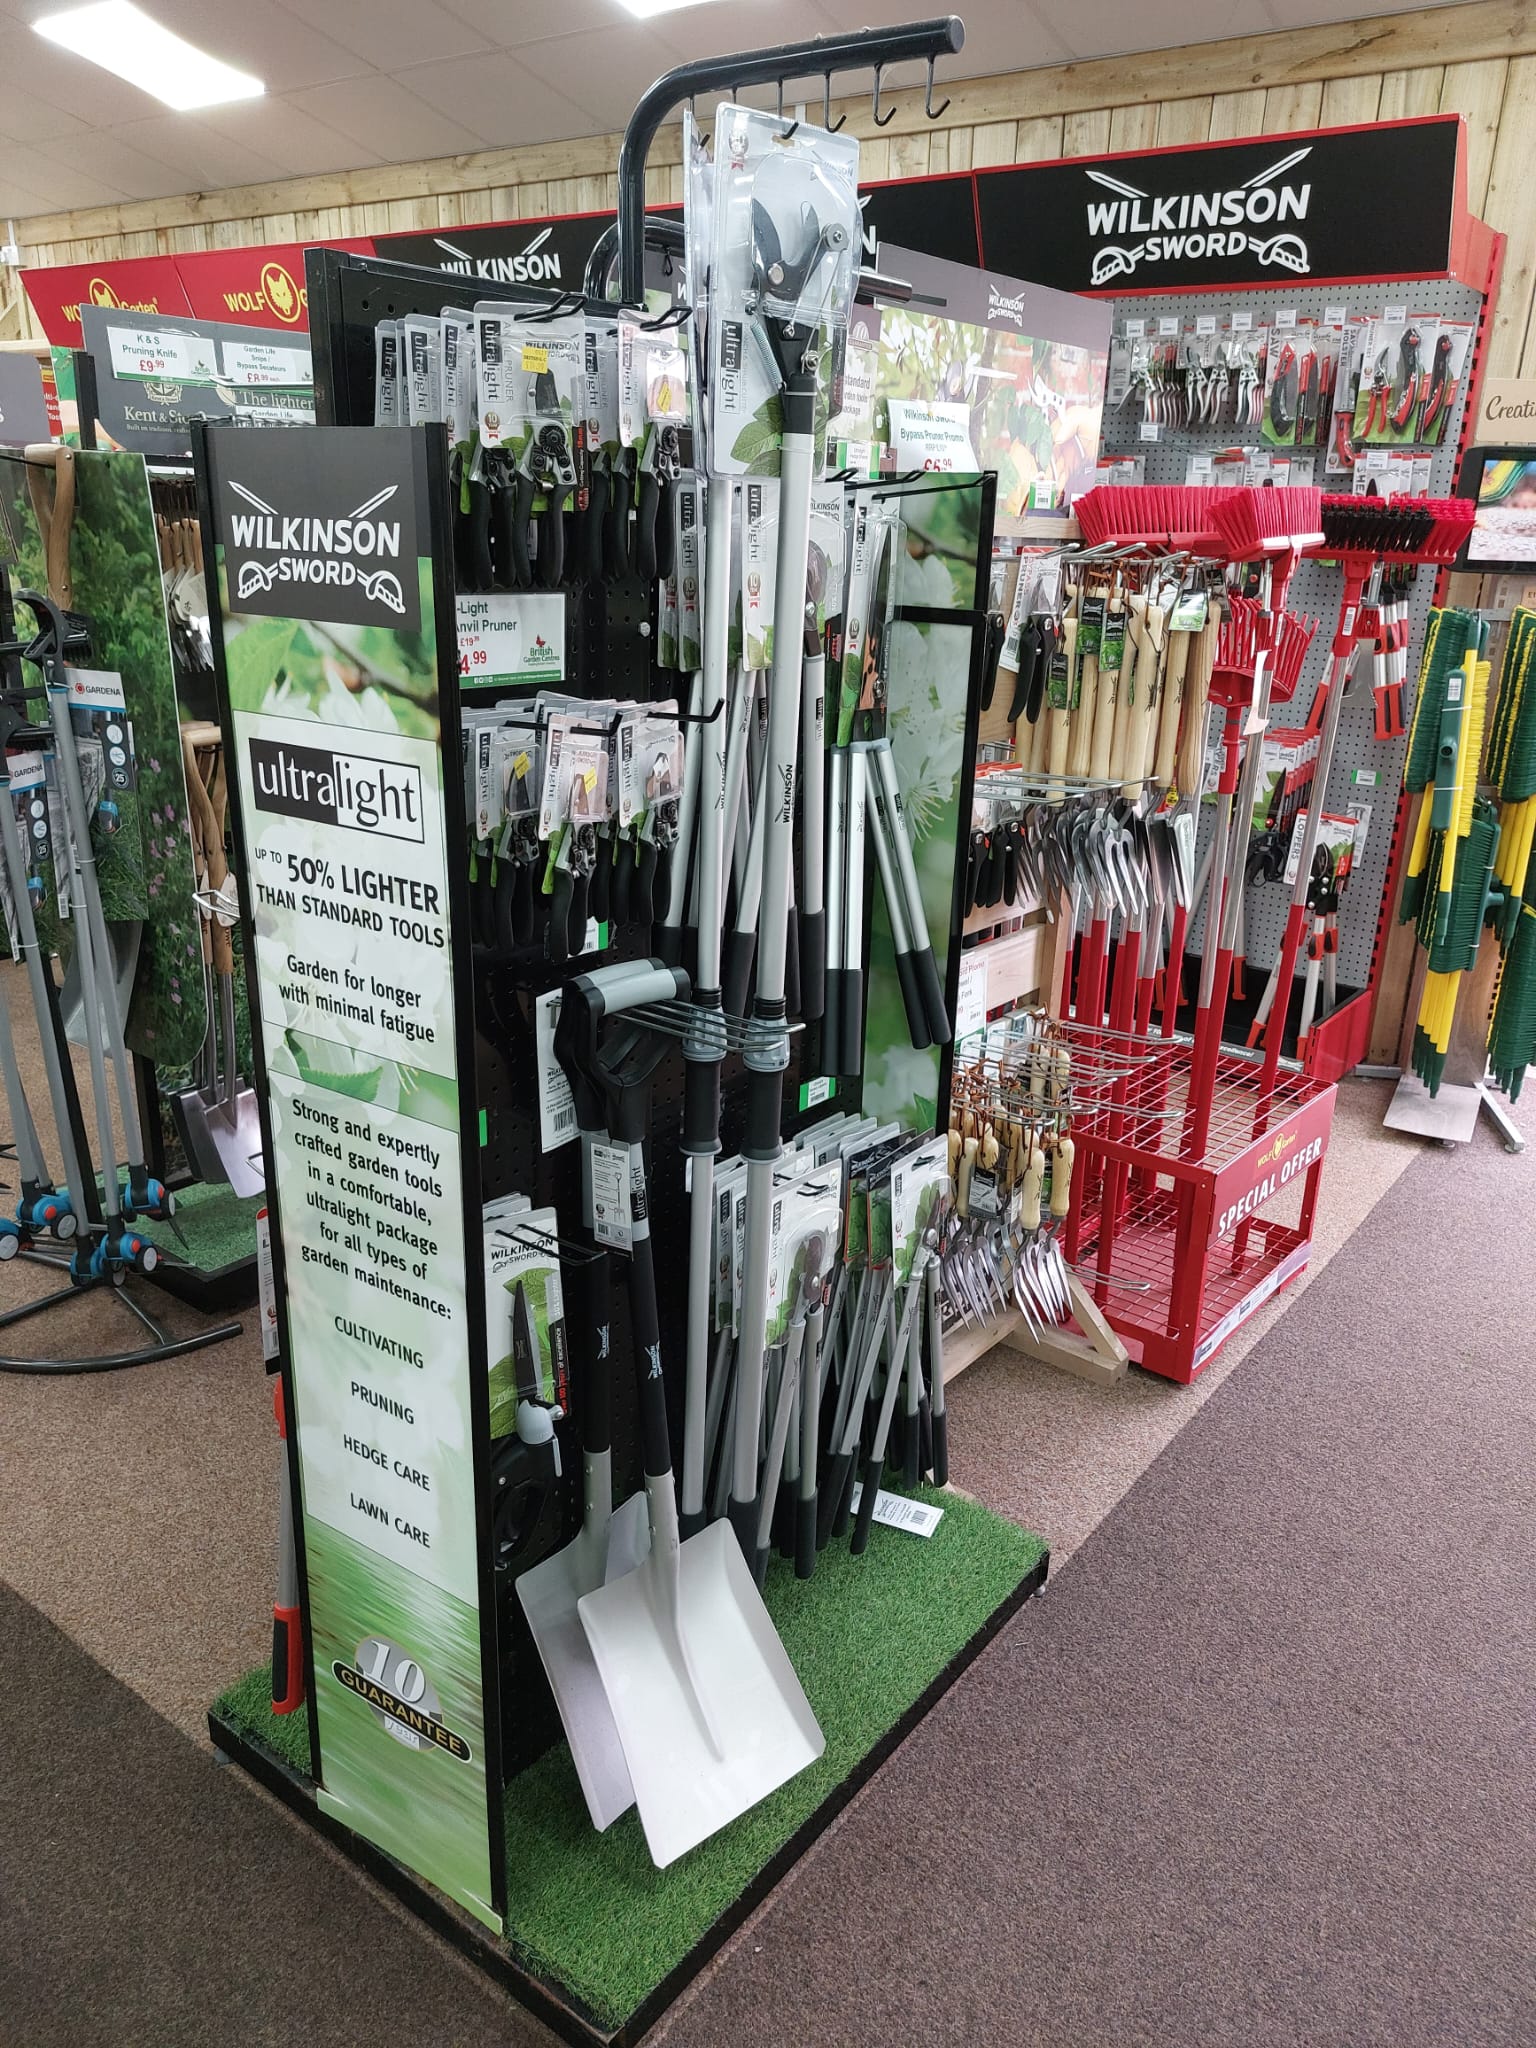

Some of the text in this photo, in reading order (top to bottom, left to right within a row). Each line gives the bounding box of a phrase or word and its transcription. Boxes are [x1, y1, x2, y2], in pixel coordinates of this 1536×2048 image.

[1087, 184, 1311, 235] WILKINSON
[1145, 232, 1247, 261] SWORD
[223, 293, 265, 313] WOLF
[988, 294, 1024, 312] WILKINSON
[122, 345, 178, 359] Pruning Knife
[136, 334, 161, 345] K & S
[446, 328, 458, 403] ultralight
[483, 322, 501, 401] ultralight
[1269, 327, 1281, 358] SAW
[139, 359, 165, 373] £9.99
[382, 340, 395, 412] ultralight
[413, 334, 428, 409] ultralight
[723, 322, 739, 410] ultralight
[124, 405, 190, 425] Kent & Sto
[239, 390, 313, 410] The lighter
[900, 428, 965, 442] Bypass Pruner Promo
[810, 502, 840, 512] ILKINSON
[1355, 466, 1366, 496] SHE
[231, 514, 400, 557] WILKINSON
[682, 494, 695, 568] ultralight
[278, 557, 356, 586] SWORD
[1014, 555, 1027, 610] PRUNER
[482, 620, 517, 632] Pruner
[529, 646, 553, 657] British
[85, 683, 121, 697] GARDENA
[14, 762, 43, 779] GARDENA
[258, 750, 418, 827] ultralight
[782, 764, 793, 824] WILKINSON
[1291, 817, 1304, 860] LOPPERS
[255, 848, 441, 916] UP TO 50% LIGHTER
[256, 884, 445, 949] THAN STANDARD TOOLS
[287, 954, 422, 1008] Garden for longer
[279, 983, 435, 1043] with minimal fatigue
[1220, 1044, 1255, 1057] xcellence!
[292, 1099, 440, 1170] Strong and expertly
[294, 1132, 443, 1198] crafted garden tools
[1217, 1136, 1322, 1239] SPECIAL OFFER
[307, 1161, 433, 1226] in a comfortable,
[631, 1166, 648, 1221] ultralight
[306, 1191, 439, 1256] ultralight package
[490, 1238, 554, 1261] WILKINSON
[320, 1222, 428, 1281] for all types of
[507, 1251, 538, 1264] SWORD
[301, 1245, 349, 1276] garden
[354, 1265, 452, 1320] maintenance:
[334, 1316, 424, 1369] CULTIVATING
[555, 1327, 564, 1361] excellence
[650, 1345, 658, 1378] WILKINSON
[351, 1380, 415, 1425] PRUNING
[343, 1434, 431, 1492] HEDGE CARE
[350, 1492, 431, 1549] LAWN CARE
[363, 1636, 426, 1703] 10
[340, 1668, 462, 1755] GUARANTEE
